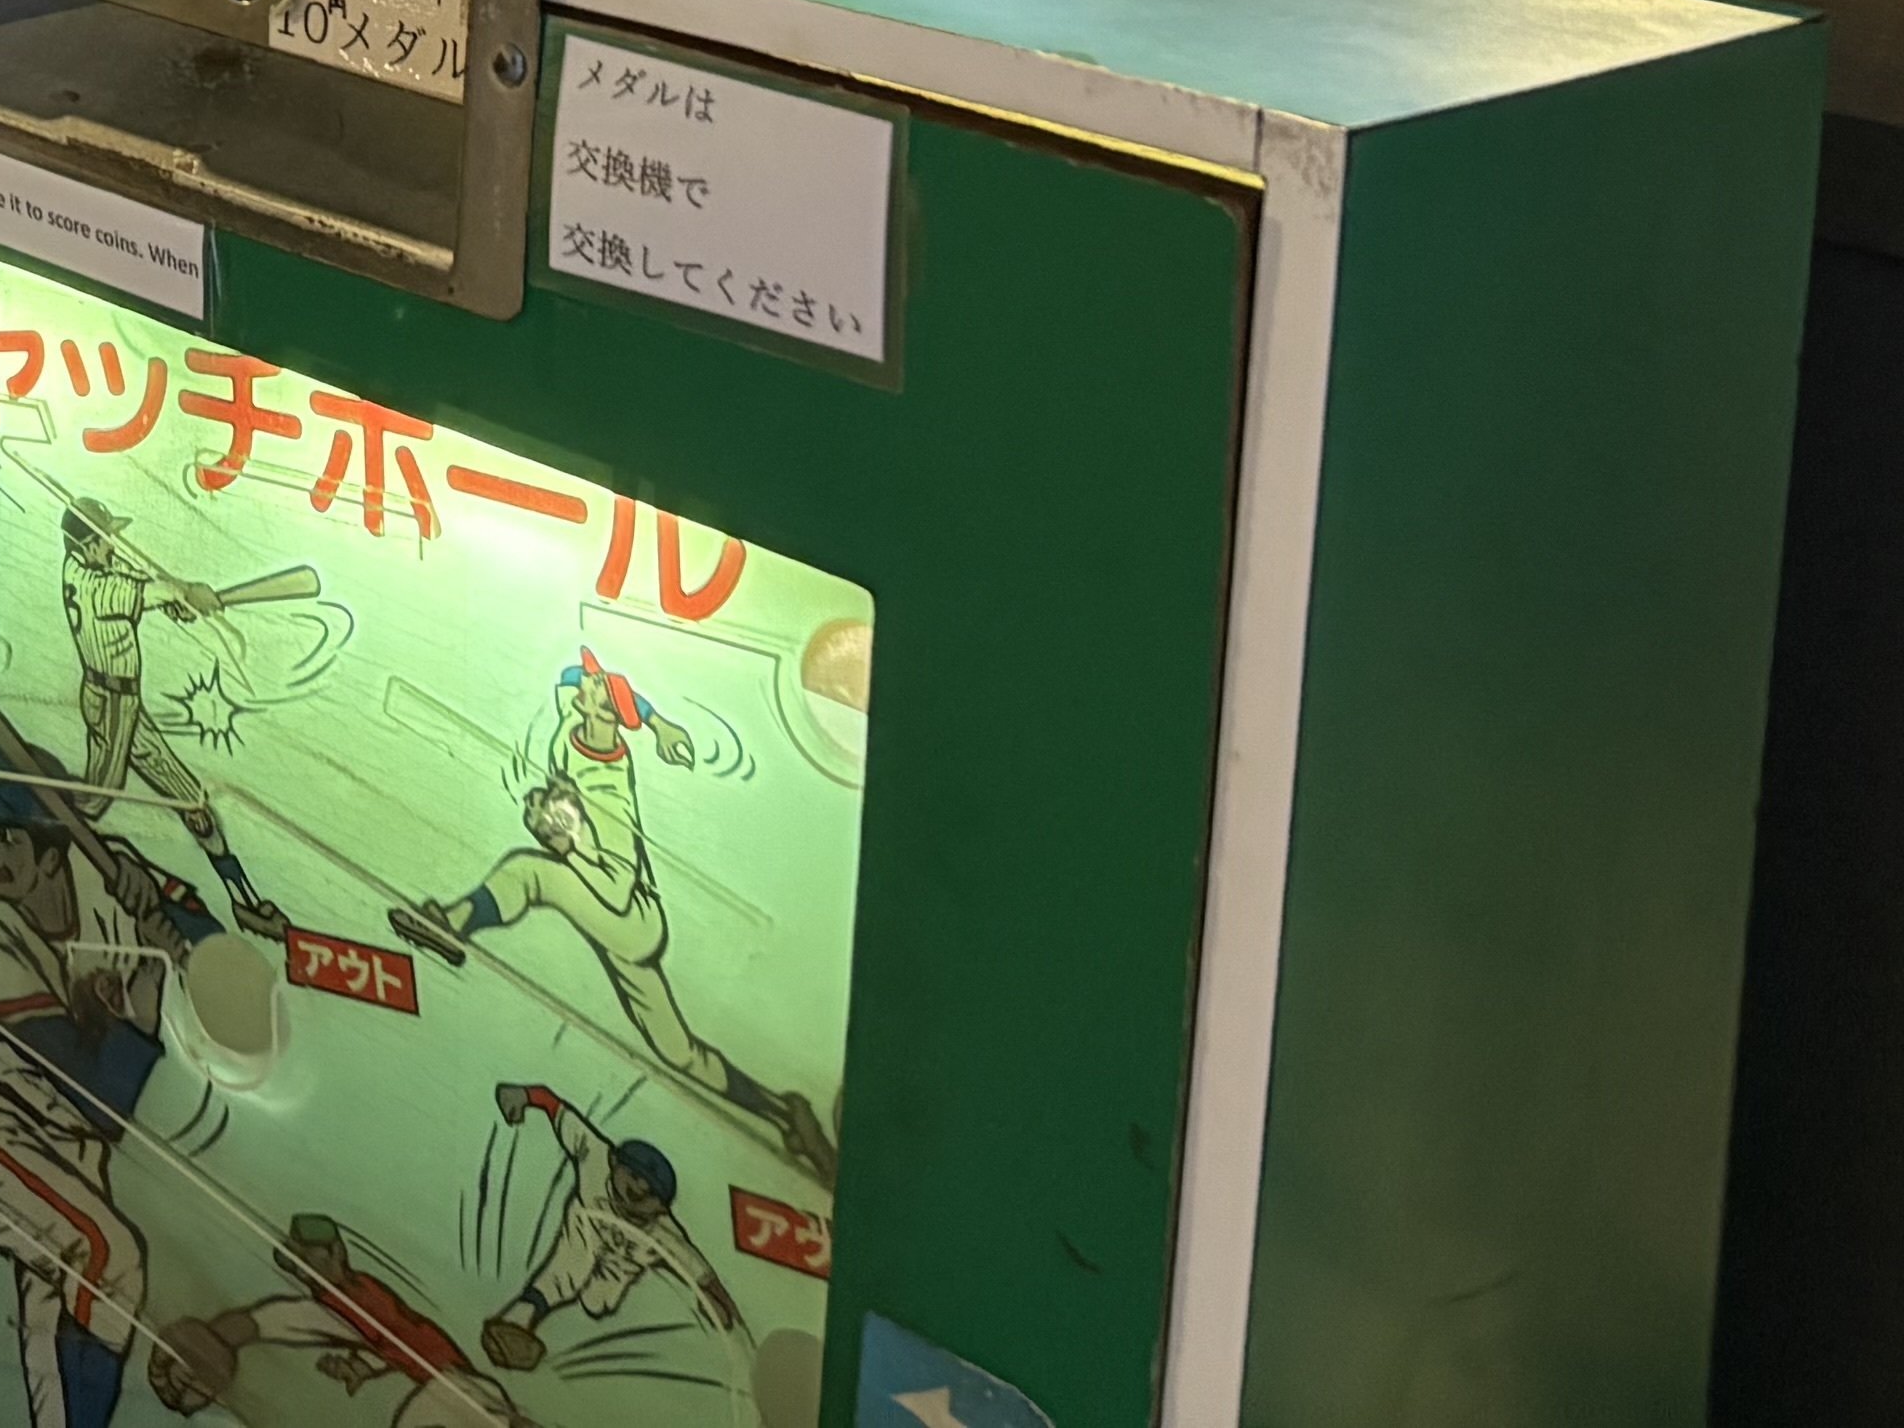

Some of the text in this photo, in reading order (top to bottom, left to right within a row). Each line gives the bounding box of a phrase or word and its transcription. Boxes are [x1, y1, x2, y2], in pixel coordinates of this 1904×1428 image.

[577, 60, 716, 125] メダルは
[567, 139, 712, 208] 交換機で
[9, 193, 22, 215] it
[25, 201, 43, 222] to
[47, 209, 91, 239] score
[95, 228, 144, 259] coins.
[148, 243, 200, 279] When
[562, 223, 863, 336] 交換してください
[297, 940, 403, 1002] アウト
